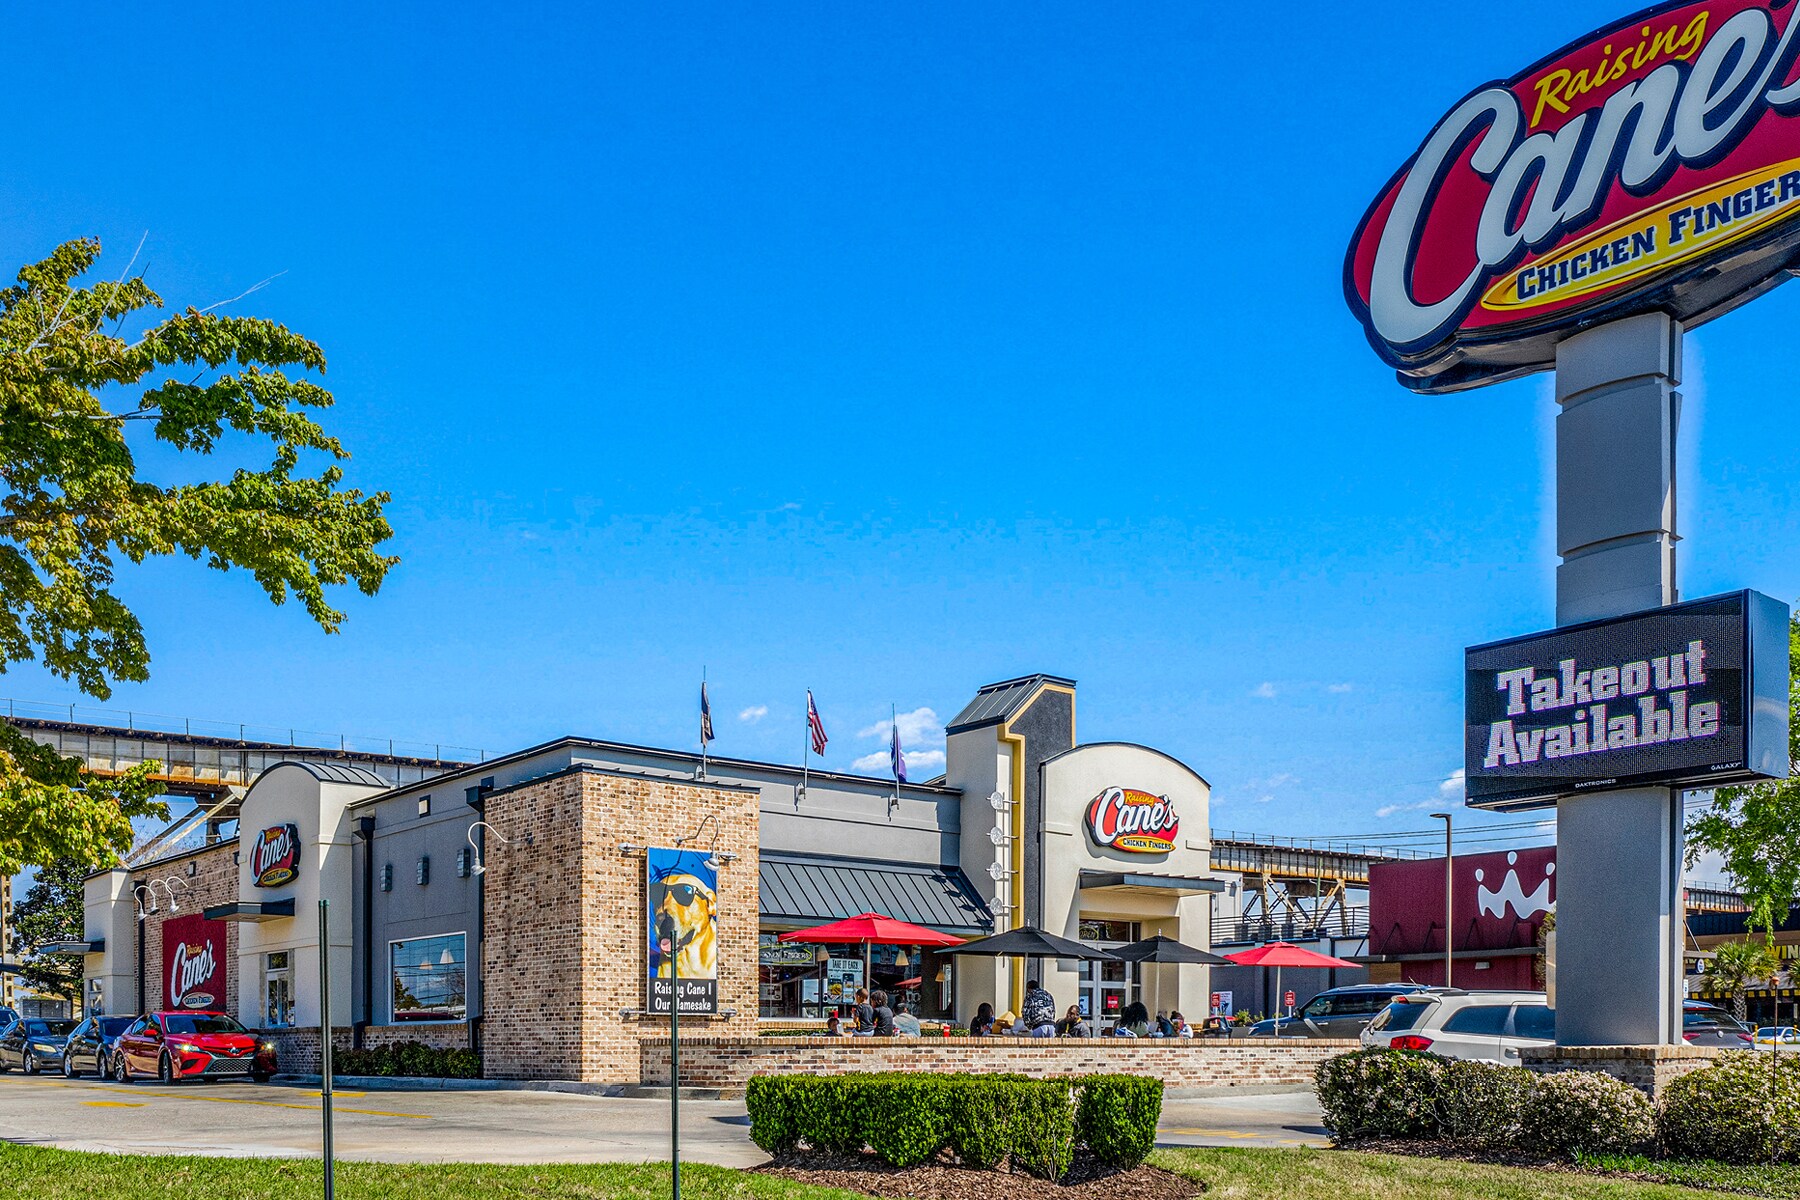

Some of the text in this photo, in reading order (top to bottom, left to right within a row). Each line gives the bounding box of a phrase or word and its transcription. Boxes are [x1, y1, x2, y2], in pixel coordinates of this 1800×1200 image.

[1530, 10, 1709, 128] Raising
[1370, 0, 1800, 343] Cane
[1516, 226, 1656, 300] CHICKEN
[1497, 640, 1706, 716] Takeout
[1484, 690, 1720, 768] Available
[1575, 778, 1617, 789] DAKTRONICS
[1711, 762, 1742, 771] GALAXY
[1095, 787, 1179, 844] Cane's
[1125, 792, 1155, 806] Raising
[251, 825, 293, 884] Cane's
[1122, 838, 1147, 848] CHICKEN
[171, 939, 216, 1007] Cane's
[654, 981, 684, 998] Raisg
[687, 981, 706, 995] Cane
[655, 997, 671, 1010] Our
